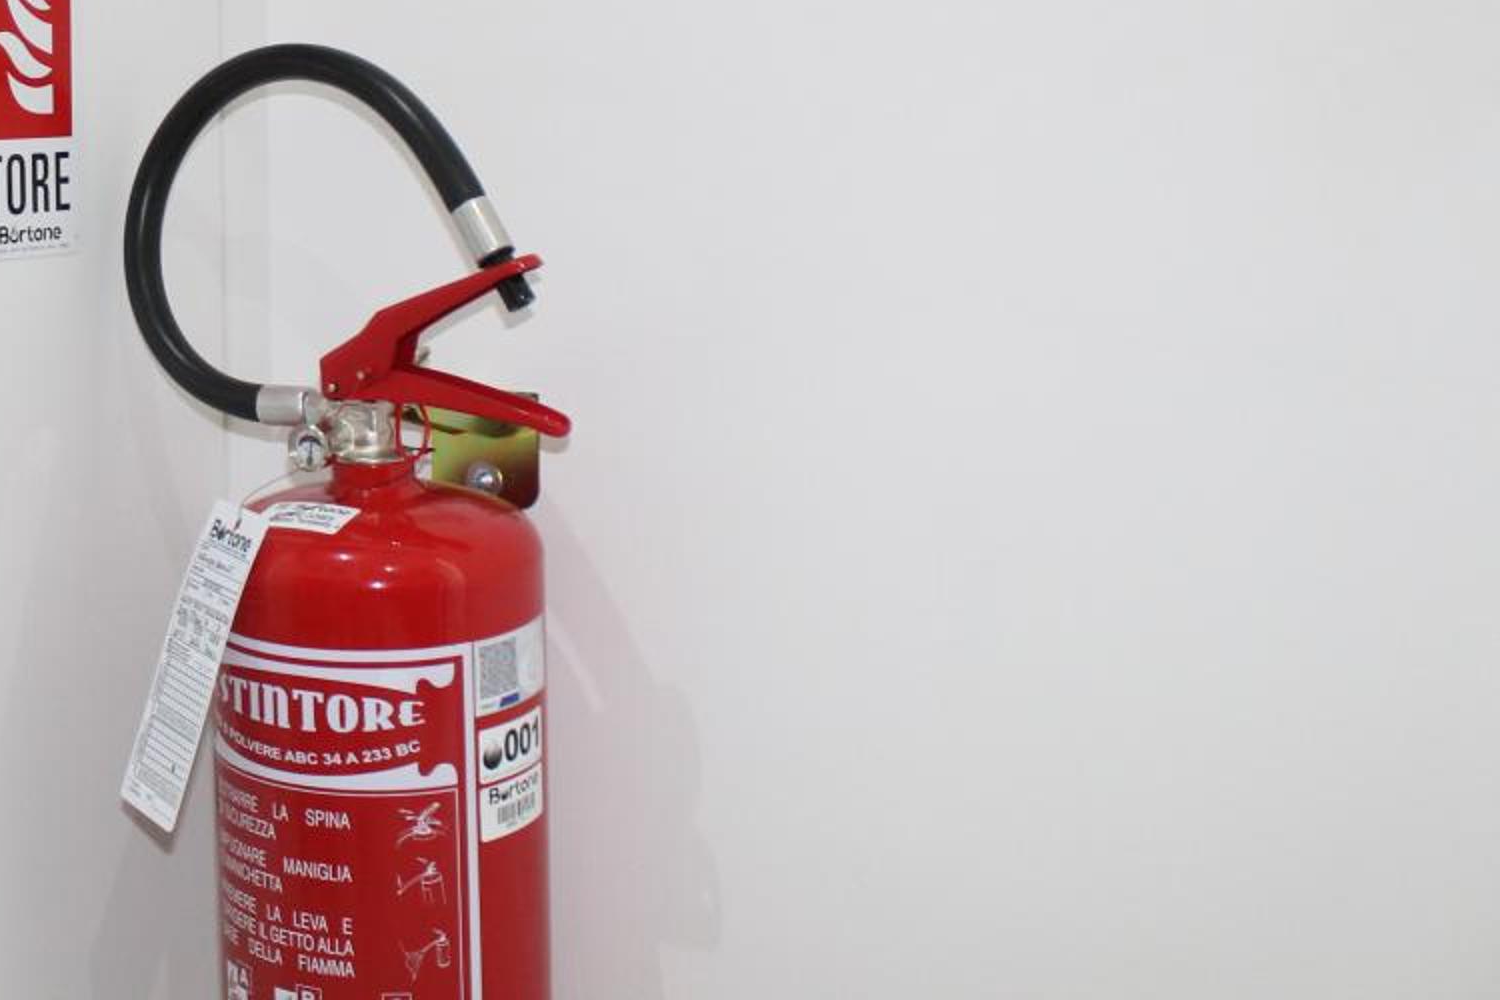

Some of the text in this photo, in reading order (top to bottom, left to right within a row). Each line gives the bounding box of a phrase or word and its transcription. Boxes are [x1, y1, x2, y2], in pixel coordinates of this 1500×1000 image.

[218, 674, 425, 733] STINTORE
[229, 727, 282, 761] POLVERE
[284, 747, 319, 765] ABC
[323, 752, 342, 766] 34
[345, 751, 360, 766] A
[361, 747, 392, 763] 233
[395, 740, 421, 757] BC
[504, 716, 539, 761] 001
[272, 801, 289, 821] LA
[305, 808, 351, 830] SPINA
[283, 856, 353, 882] MANIGLIA
[266, 903, 282, 923] LA
[293, 910, 329, 933] LEVA
[343, 917, 353, 935] E
[258, 922, 268, 940] IL
[269, 926, 315, 951] GETTO
[317, 936, 355, 957] ALLA
[249, 941, 356, 979] DELLA FIAMMA
